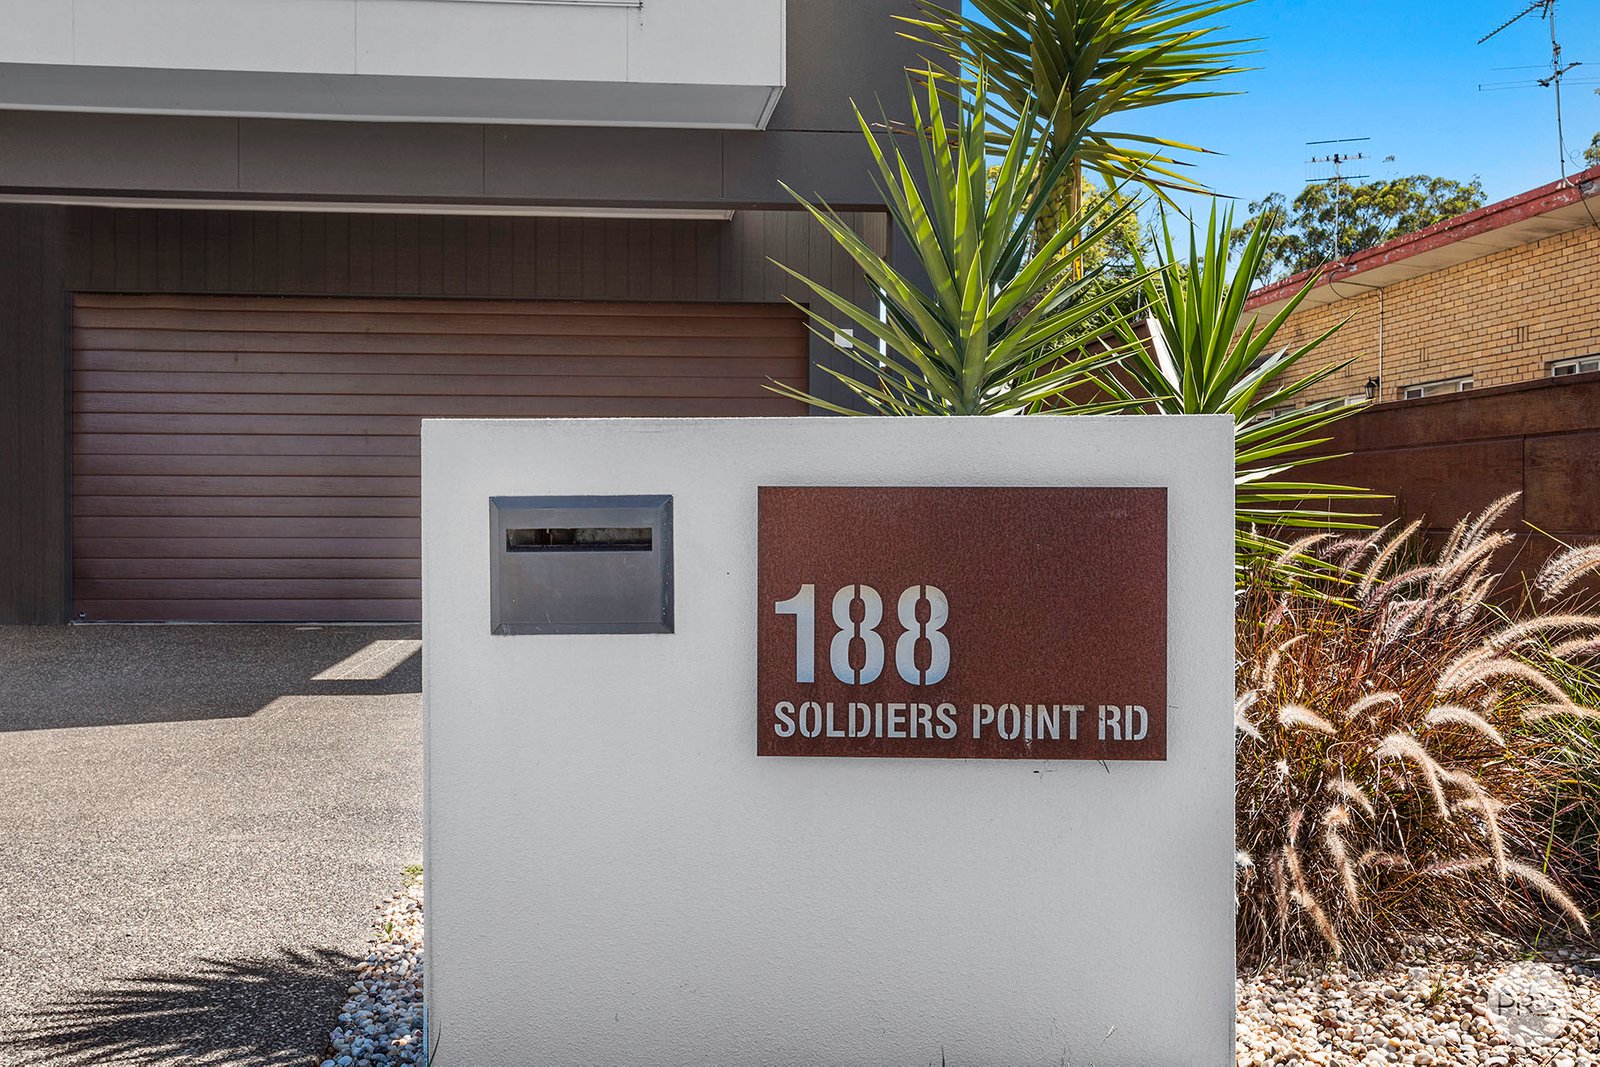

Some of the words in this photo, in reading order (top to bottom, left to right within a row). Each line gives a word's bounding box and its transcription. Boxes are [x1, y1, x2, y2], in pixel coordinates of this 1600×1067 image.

[774, 583, 951, 686] 188
[774, 701, 958, 739] SOLDIERS
[972, 703, 1085, 740] POINT
[1098, 704, 1149, 741] RD
